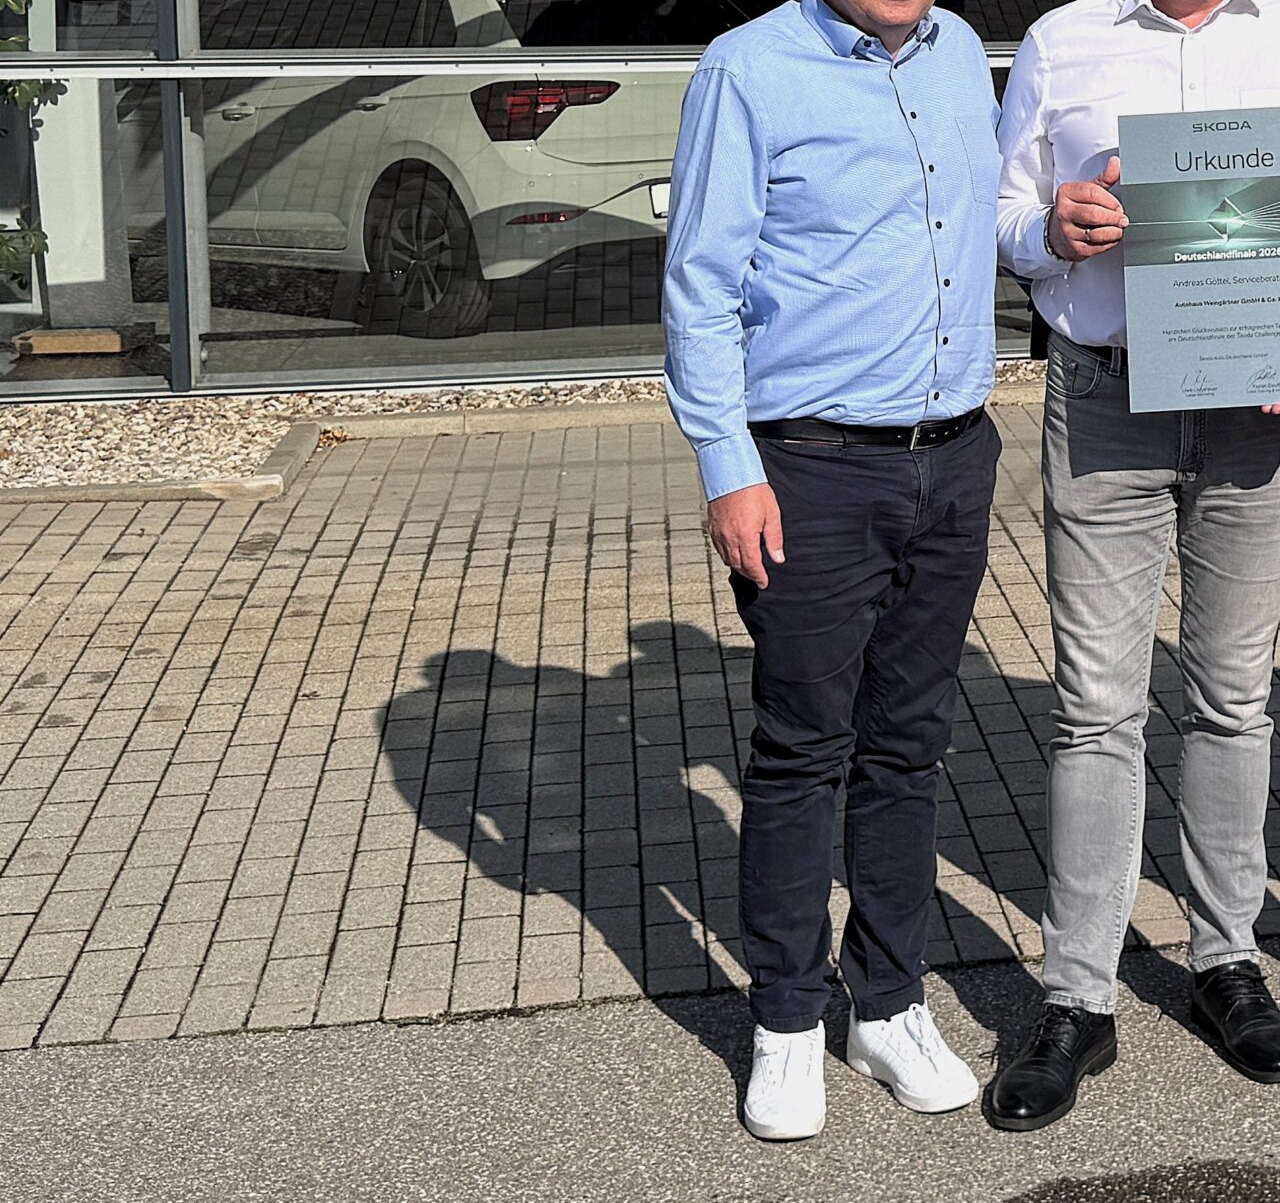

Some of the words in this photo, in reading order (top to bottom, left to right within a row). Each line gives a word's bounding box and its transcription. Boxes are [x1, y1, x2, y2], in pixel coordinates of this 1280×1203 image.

[1174, 147, 1274, 172] Urkunde
[1174, 249, 1257, 262] Deutschlandfinale
[1173, 279, 1205, 287] Andreas
